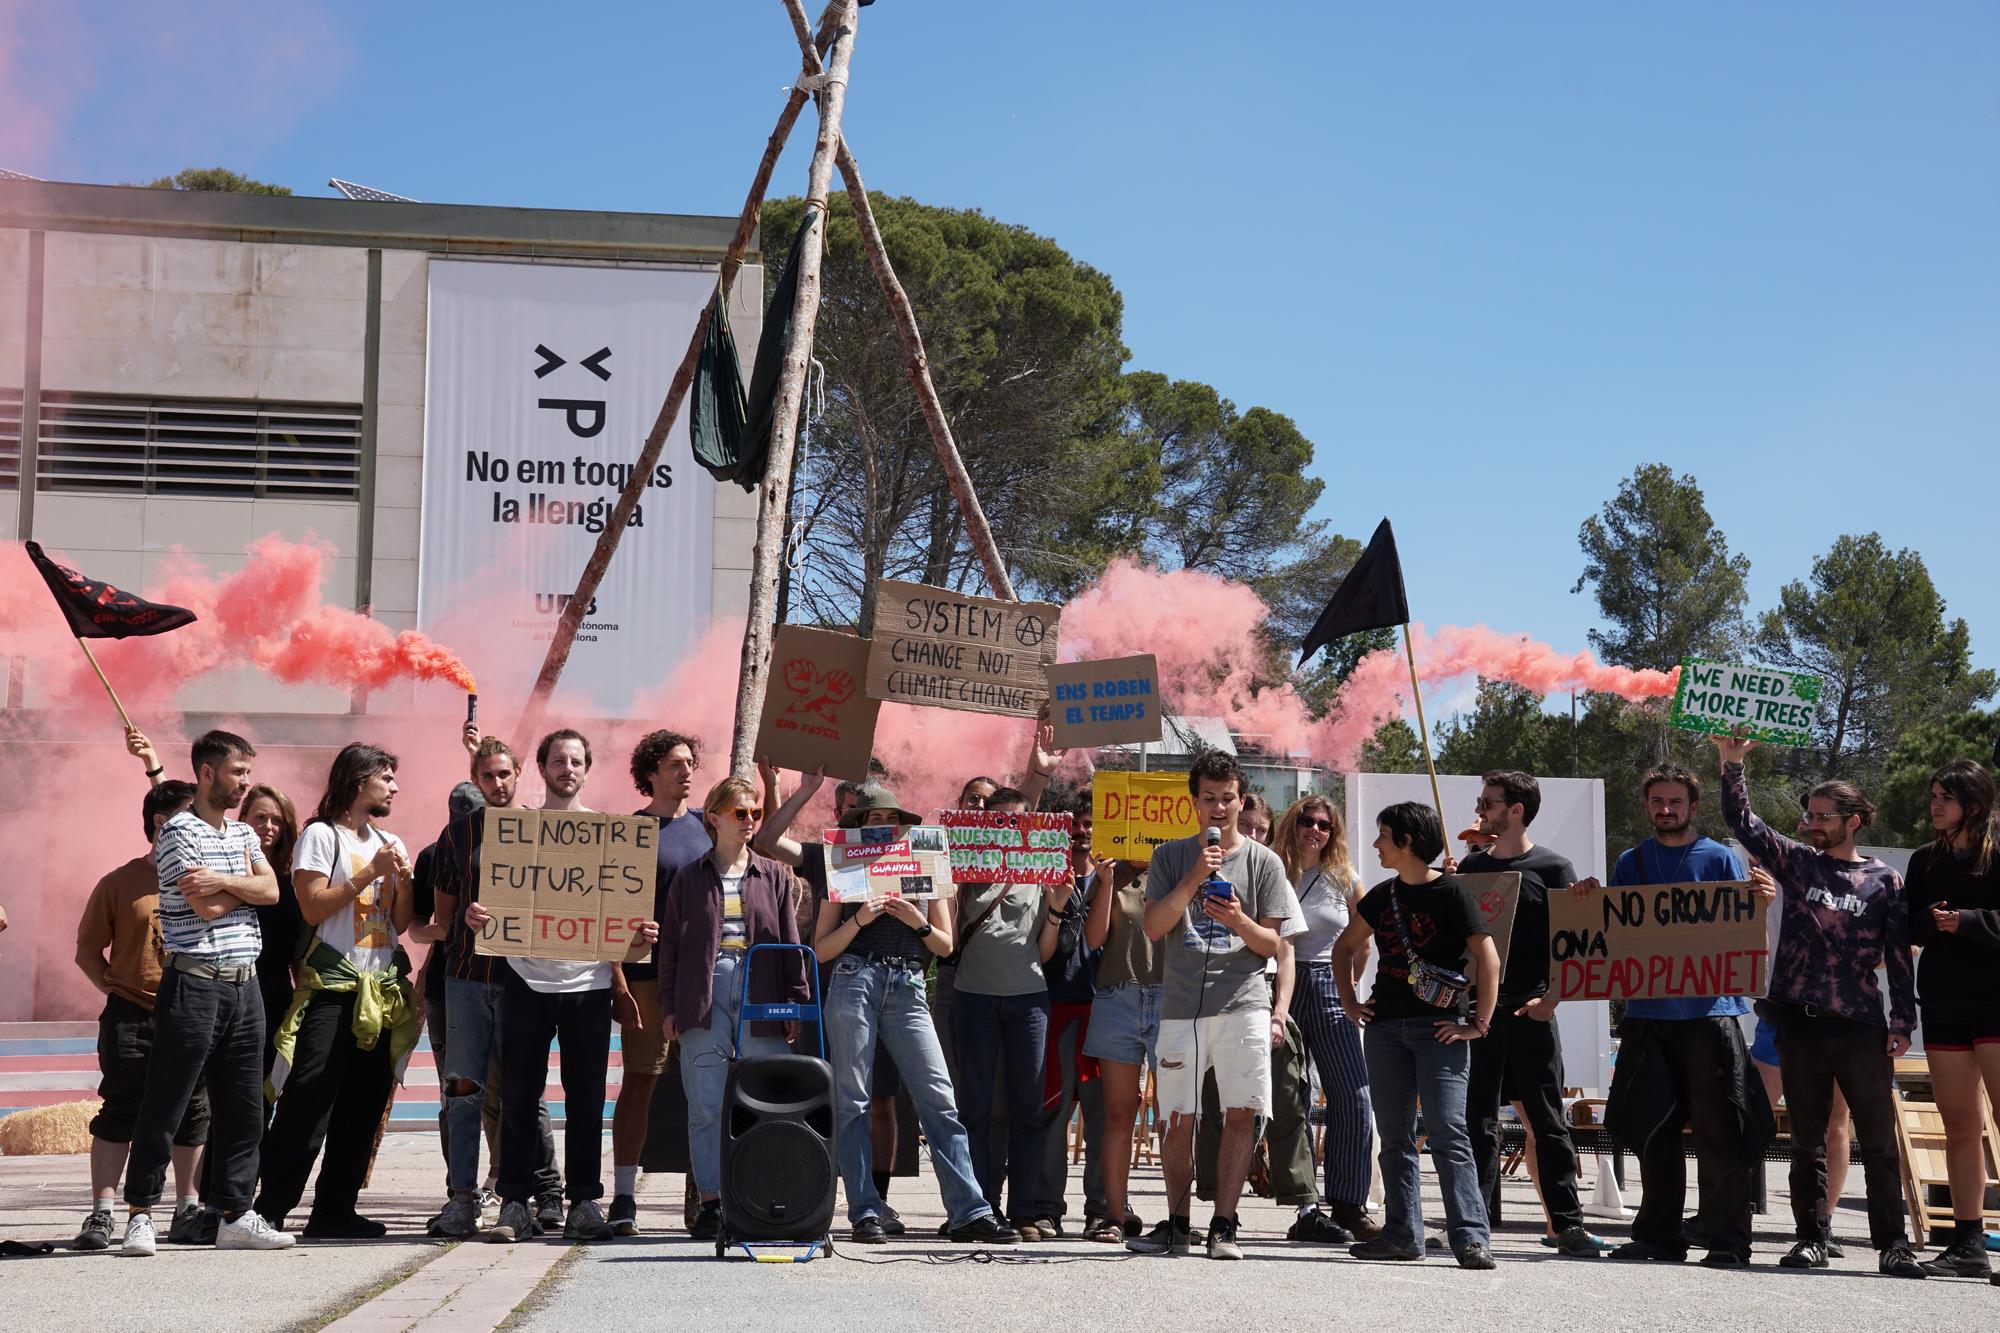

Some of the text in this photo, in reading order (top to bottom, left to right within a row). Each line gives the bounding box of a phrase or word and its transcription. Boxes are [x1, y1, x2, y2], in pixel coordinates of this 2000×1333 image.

[466, 450, 509, 483] No
[517, 458, 565, 485] em
[493, 491, 521, 523] la
[906, 598, 1002, 642] SYSTEM
[891, 638, 1014, 675] CHANGE NOT
[888, 671, 1033, 710] CLIMATE CHANGE
[1056, 678, 1152, 701] ENS ROBEN
[1692, 665, 1785, 697] WE NEED
[1066, 702, 1145, 724] EL TEMPS
[1686, 689, 1813, 728] MORE TREES
[1103, 791, 1202, 825] DEGRO
[498, 817, 653, 849] EL NOSTRE
[949, 828, 1069, 847] NUESTRA CASA
[1112, 835, 1127, 845] or
[846, 842, 906, 858] OCUPAR FINS
[949, 849, 1064, 868] ESTA EN LLAMAS
[598, 858, 644, 895] ÉS
[872, 864, 918, 873] GUANYAR!
[1603, 887, 1756, 932] NO GROWTH
[483, 914, 646, 948] DE TOTES
[1560, 950, 1769, 999] DEAD PLANET
